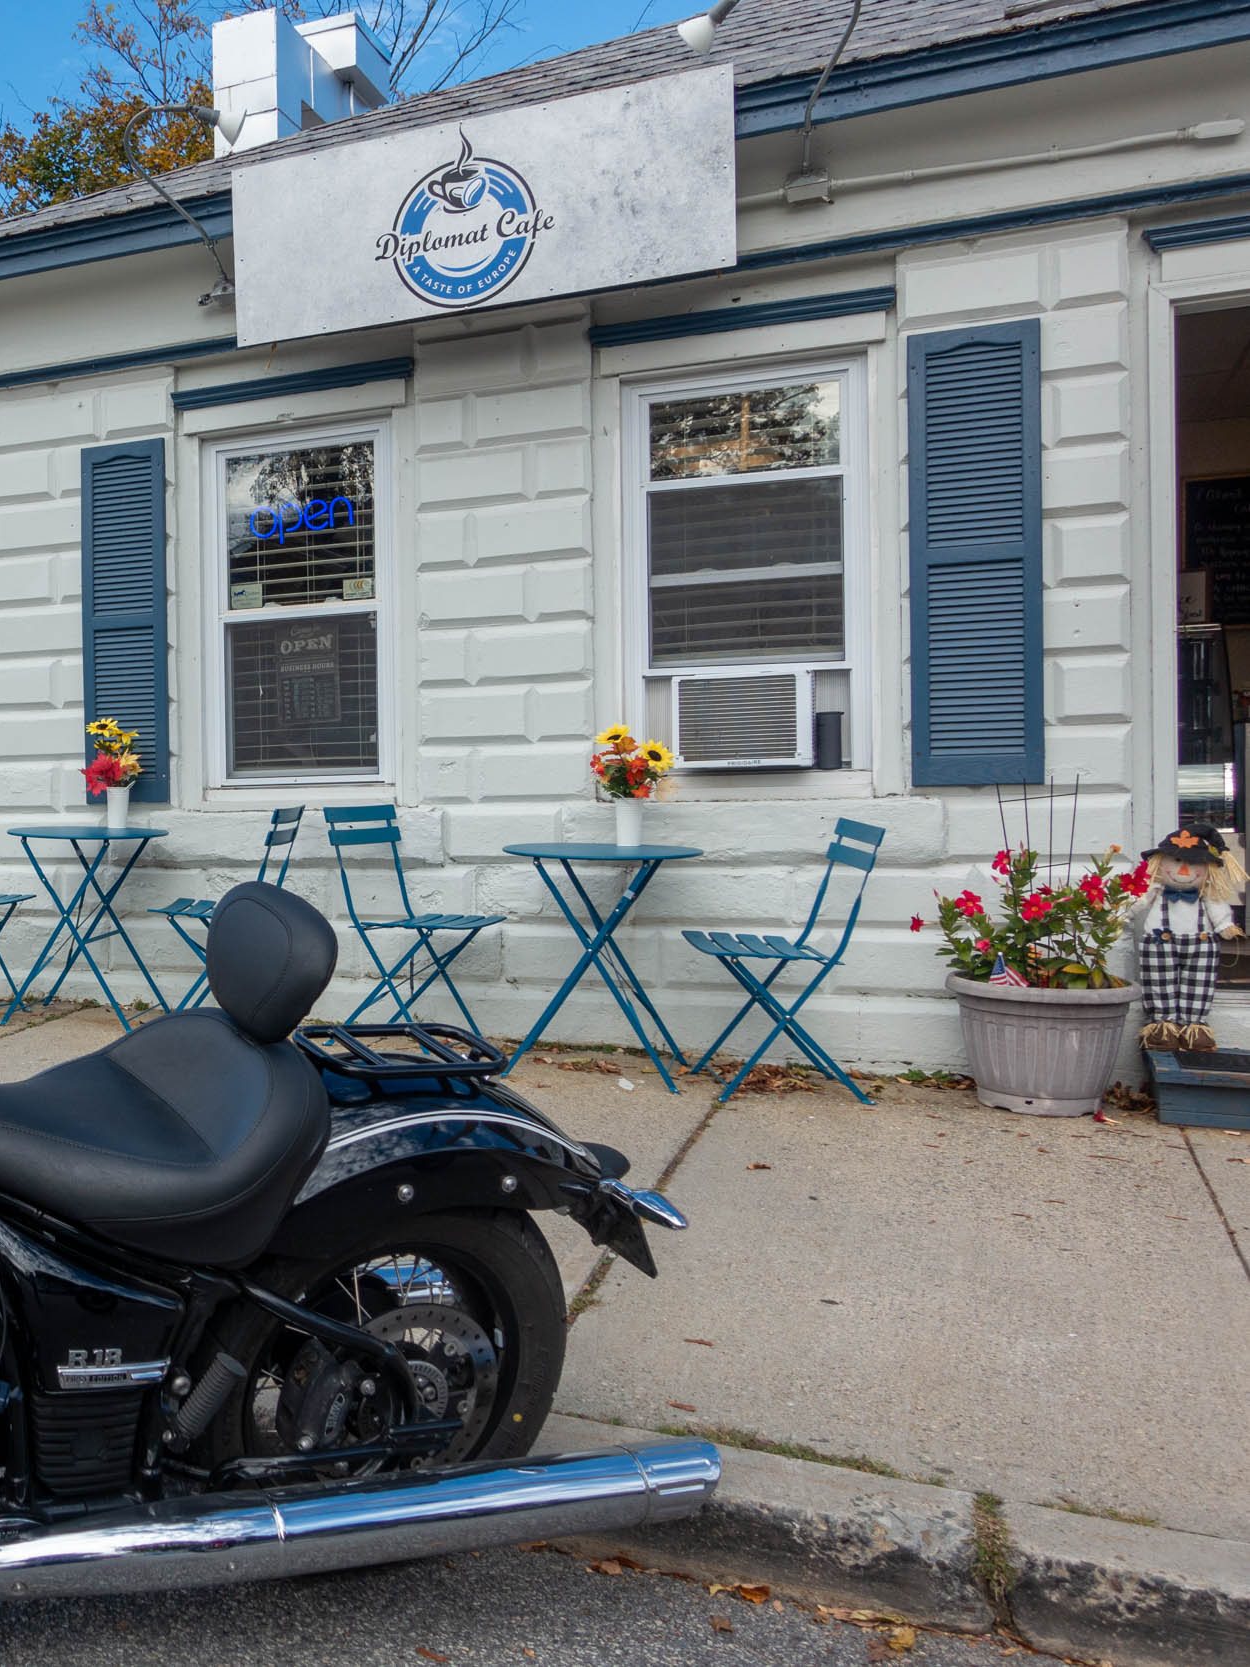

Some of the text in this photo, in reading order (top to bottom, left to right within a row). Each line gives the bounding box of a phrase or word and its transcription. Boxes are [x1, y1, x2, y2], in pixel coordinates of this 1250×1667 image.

[374, 208, 556, 262] Diplomat Cafe
[411, 249, 517, 295] A TASTE OF EUROPE
[250, 495, 355, 545] open
[280, 634, 333, 655] OPEN
